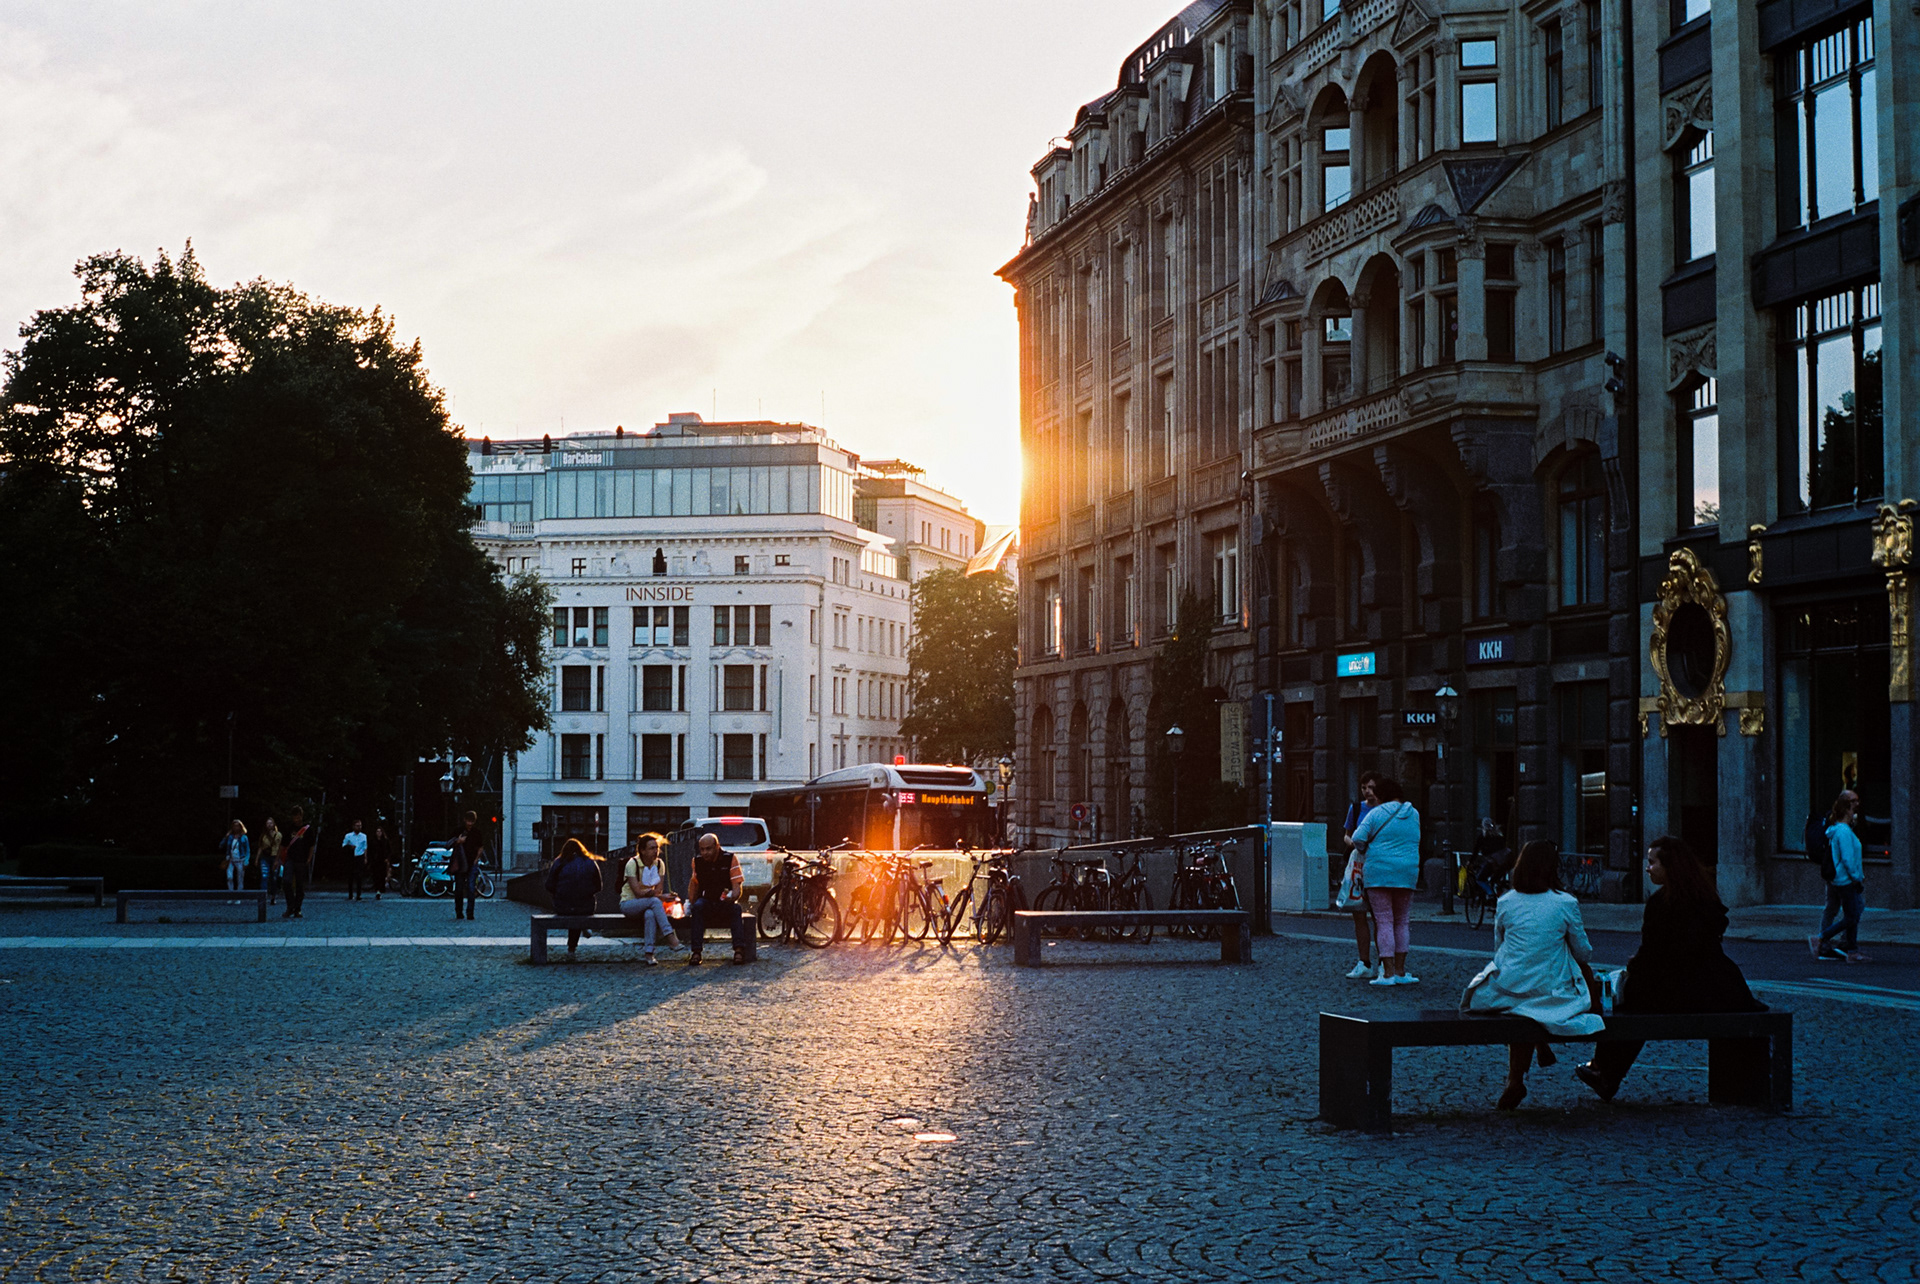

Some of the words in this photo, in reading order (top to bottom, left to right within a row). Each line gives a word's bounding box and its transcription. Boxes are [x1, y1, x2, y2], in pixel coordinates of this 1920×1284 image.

[563, 452, 602, 465] BarCabana
[626, 587, 694, 601] INNSIDE
[1479, 640, 1502, 660] KKH
[1229, 706, 1240, 737] SILKE
[1406, 713, 1436, 724] KKH
[921, 793, 974, 805] Hauptbahnhof
